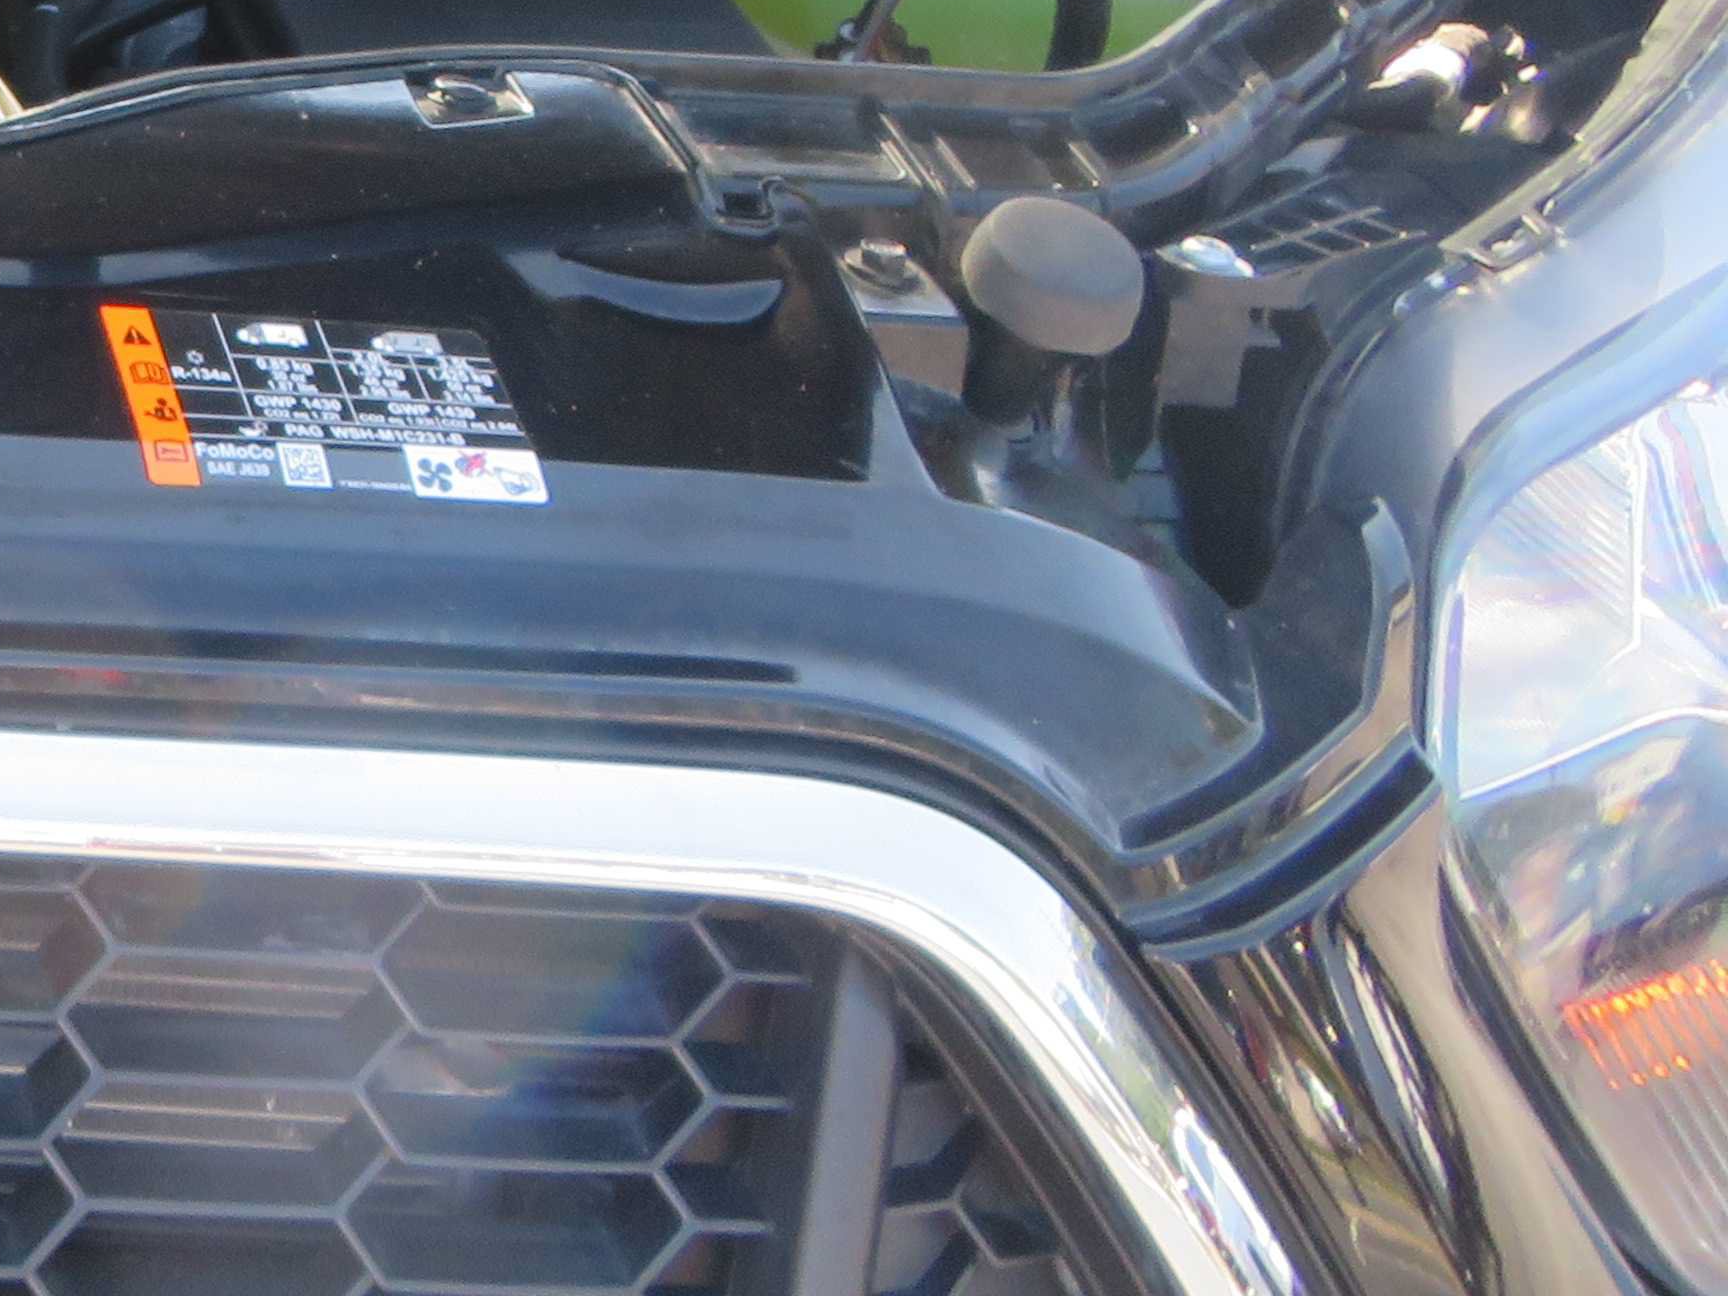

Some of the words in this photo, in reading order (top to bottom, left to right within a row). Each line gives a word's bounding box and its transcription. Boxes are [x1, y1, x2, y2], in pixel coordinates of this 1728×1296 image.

[170, 365, 233, 383] R-134a
[253, 394, 297, 409] GWP
[301, 397, 343, 413] 1430
[387, 401, 430, 416] GWP
[433, 404, 476, 420] 1430
[284, 421, 324, 439] PAG
[330, 425, 466, 446] WSH-M1C231-B
[196, 440, 275, 461] FoMoCo
[207, 460, 236, 476] SAE
